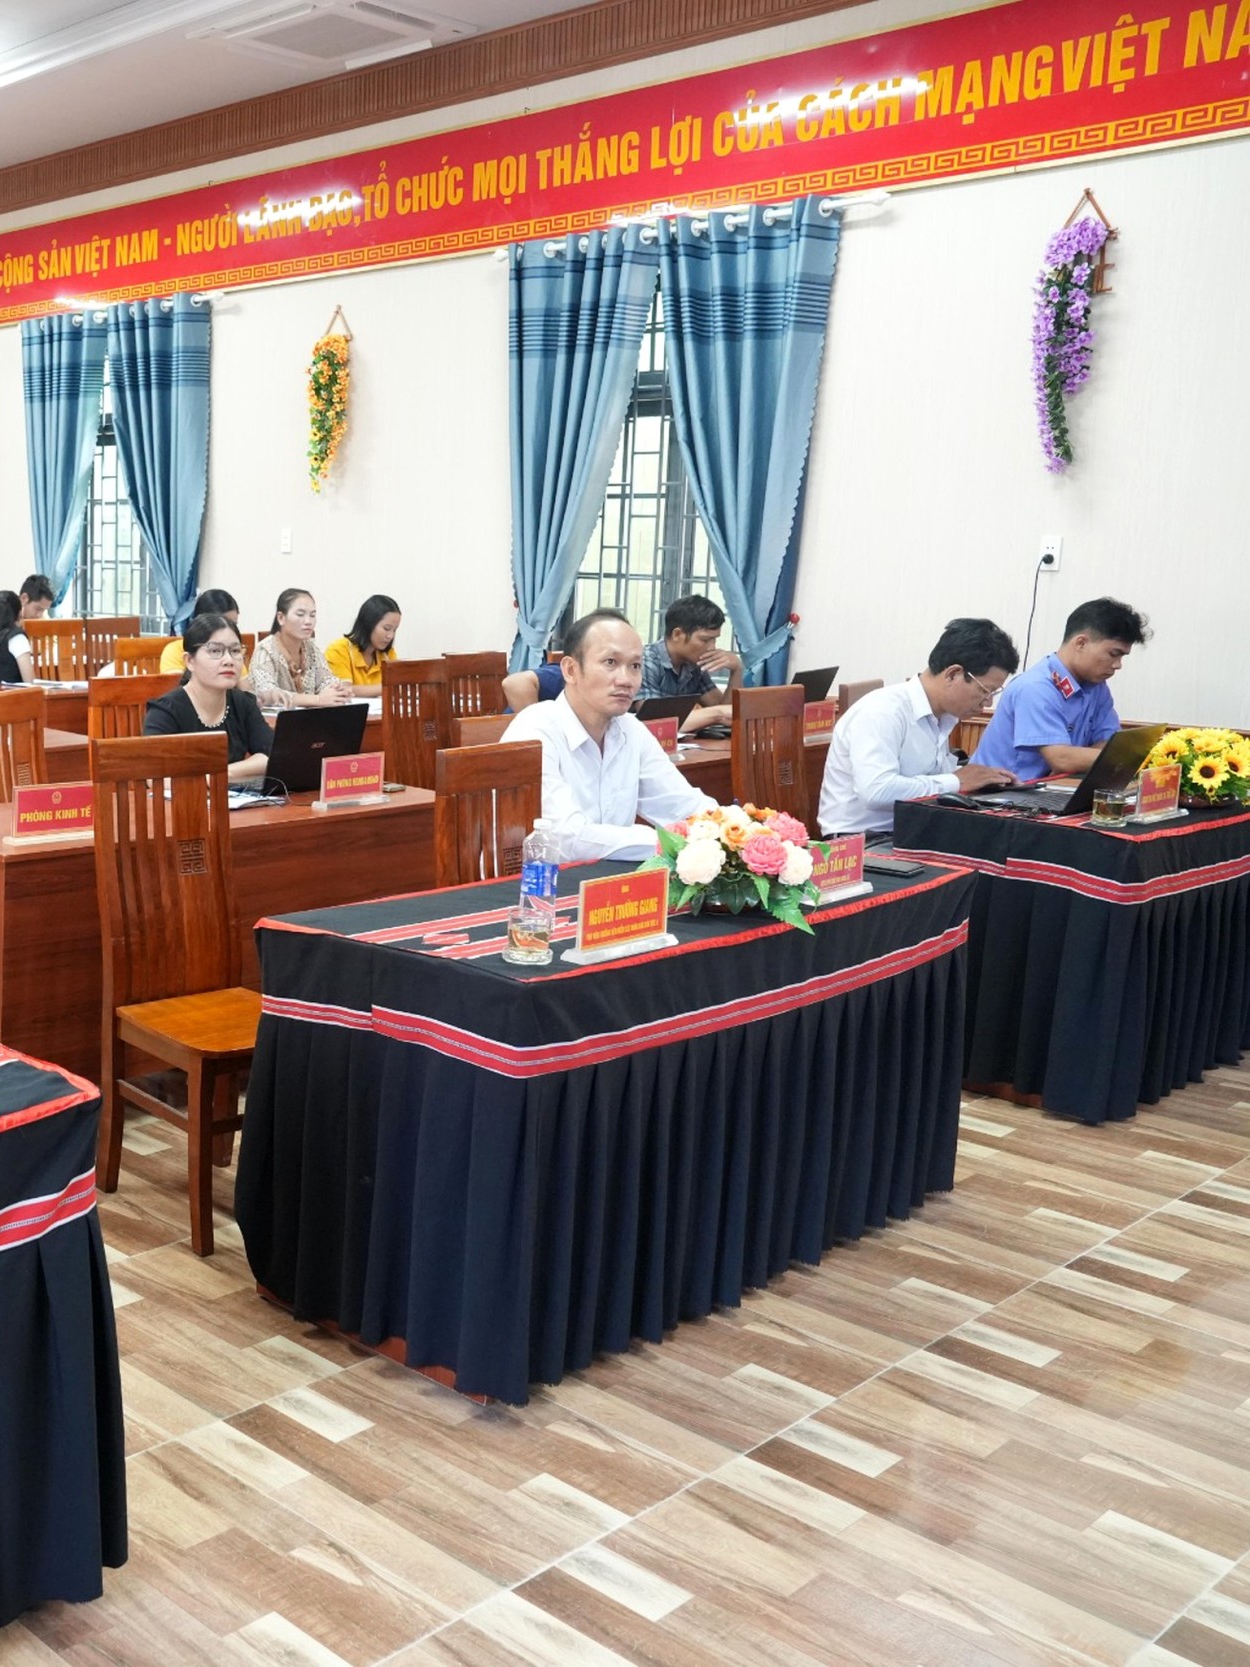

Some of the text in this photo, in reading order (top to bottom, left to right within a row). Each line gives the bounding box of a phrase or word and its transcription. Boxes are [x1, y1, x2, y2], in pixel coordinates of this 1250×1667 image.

[38, 239, 72, 279] SẢN
[74, 236, 111, 277] VIỆT
[115, 229, 158, 267] NAM
[163, 237, 172, 246] -
[176, 204, 238, 256] NGƯỜI
[361, 160, 389, 221] TỔ
[396, 156, 463, 215] CHỨC
[472, 153, 528, 205] MỌI
[536, 121, 640, 190] THẮNG
[650, 115, 702, 176] LỢI
[712, 89, 784, 158] CỦA
[795, 76, 903, 143] CÁCH
[913, 45, 1054, 125] MẠNG
[1061, 13, 1171, 94] VIỆT
[20, 804, 92, 823] PHÒNG KINH TẾ
